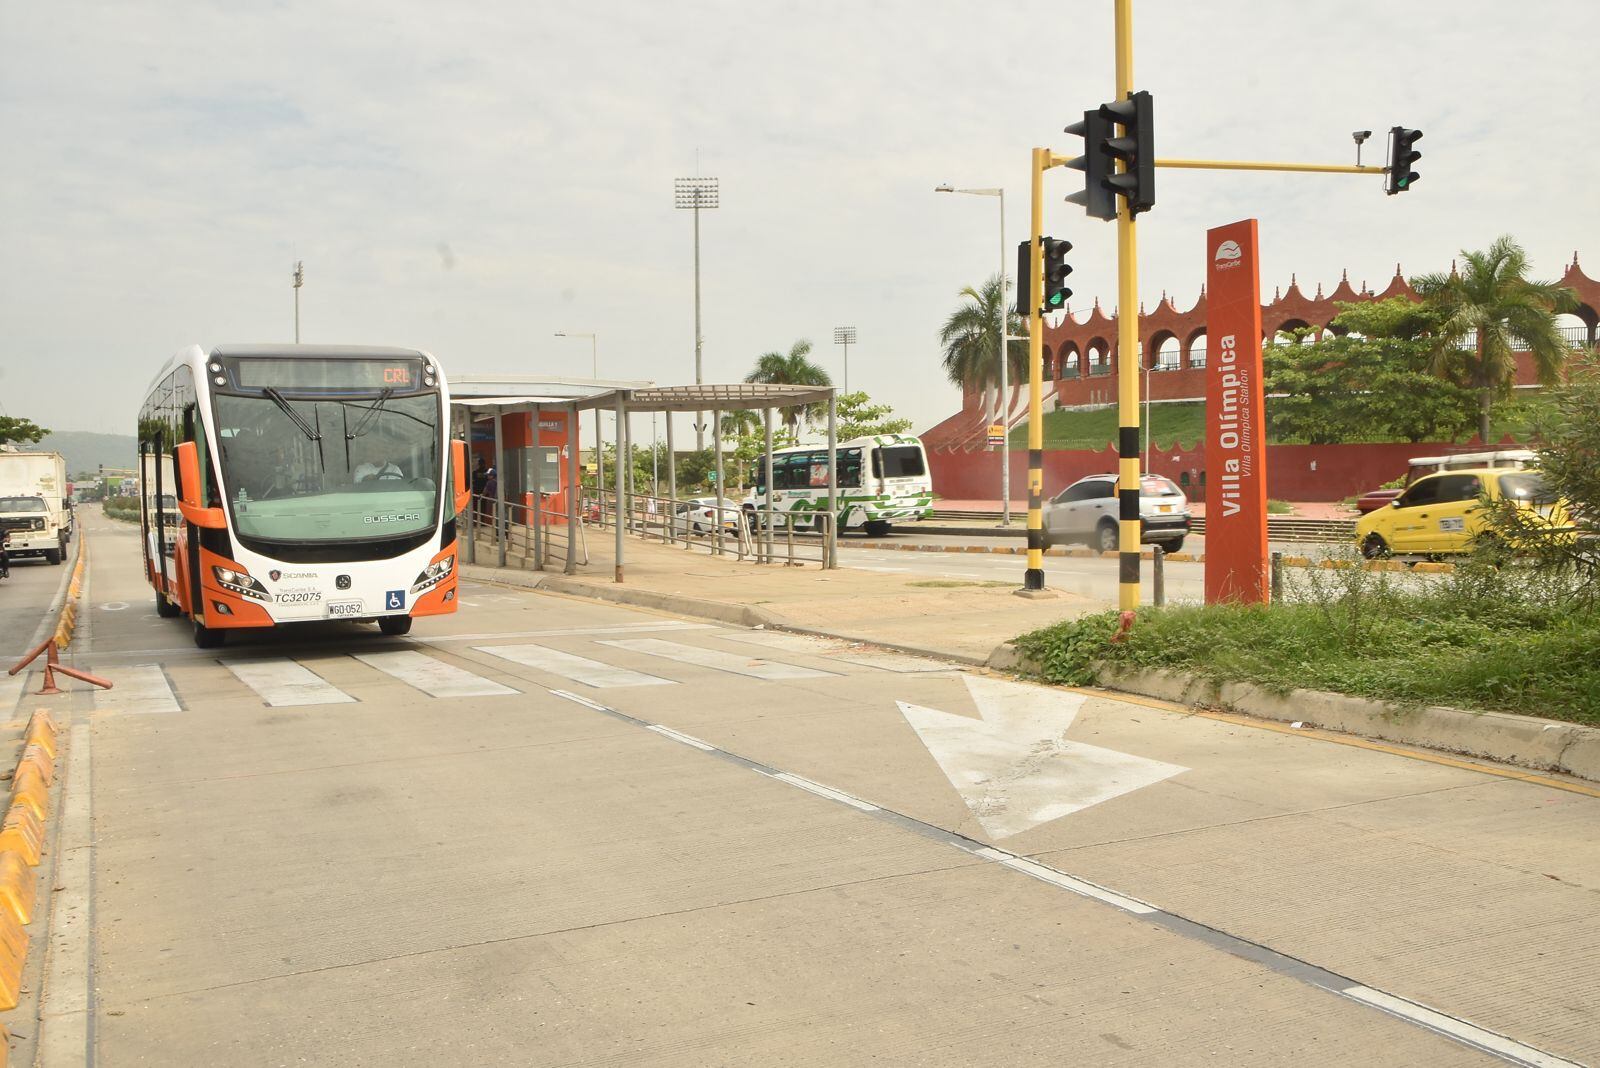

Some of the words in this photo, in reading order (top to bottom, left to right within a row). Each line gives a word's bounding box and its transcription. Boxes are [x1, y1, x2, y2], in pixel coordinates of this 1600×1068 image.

[1218, 335, 1241, 449] Olímpica
[1240, 369, 1249, 405] Station
[1242, 455, 1251, 478] Villa
[1222, 458, 1241, 517] Villa
[364, 513, 420, 524] BUSSCAR
[275, 592, 322, 603] TC32075
